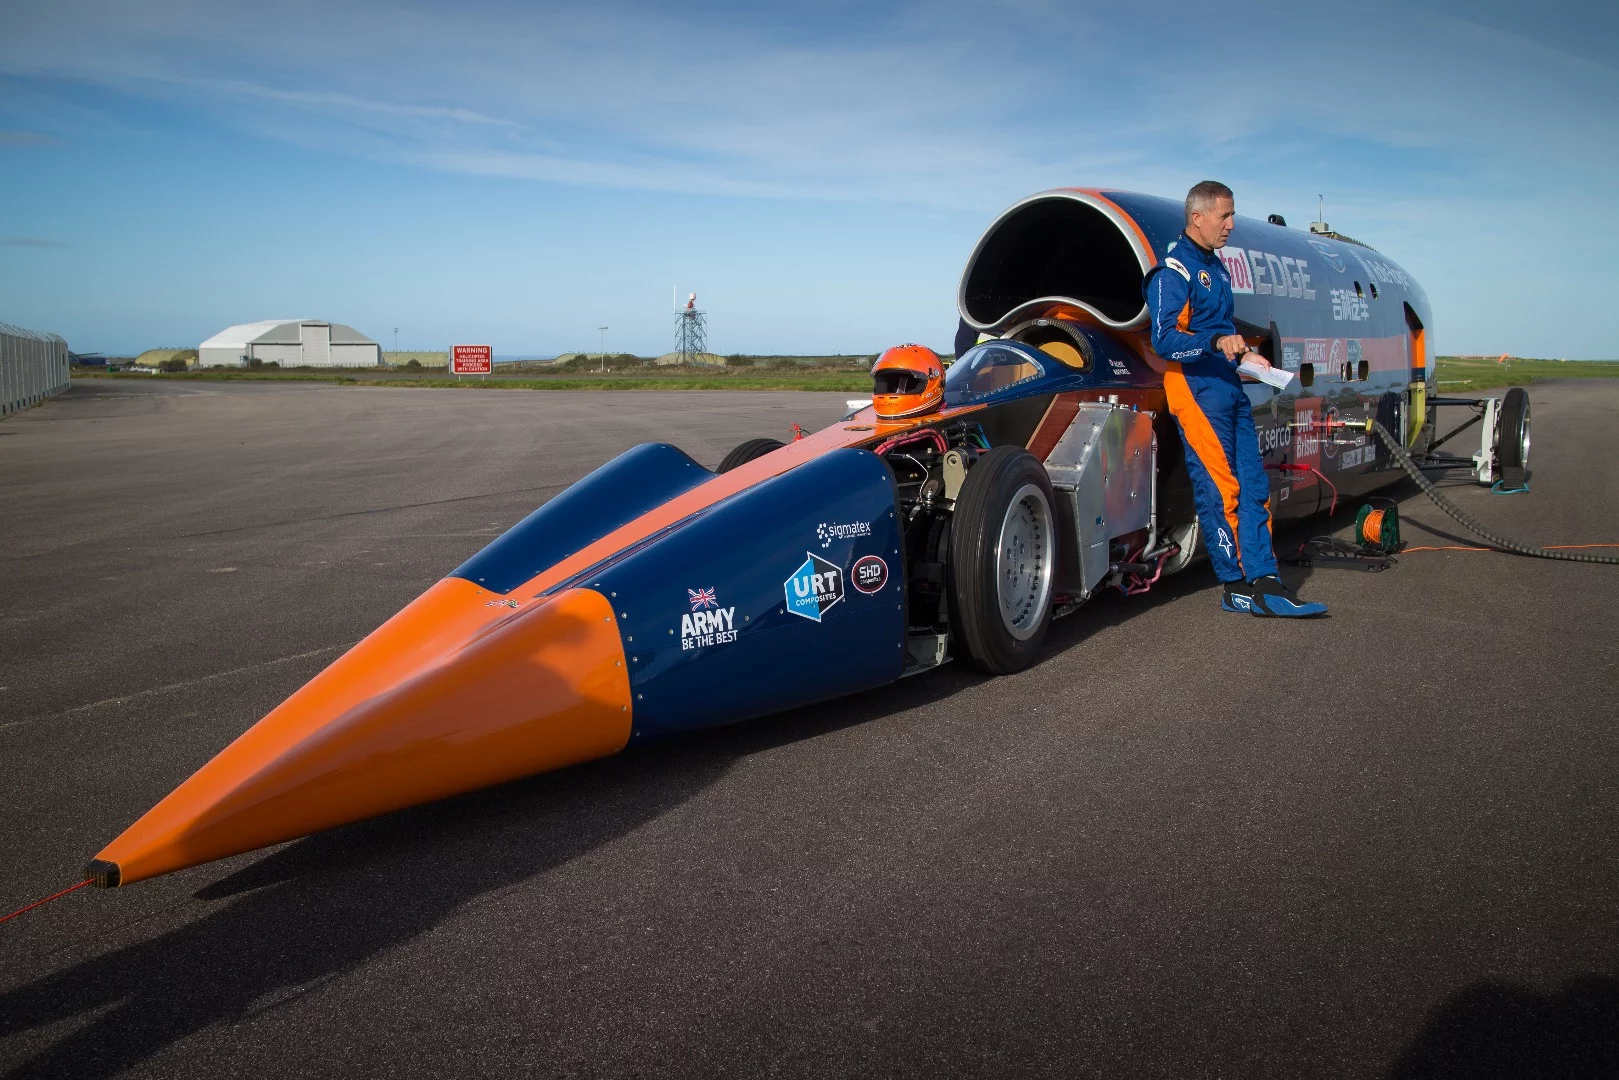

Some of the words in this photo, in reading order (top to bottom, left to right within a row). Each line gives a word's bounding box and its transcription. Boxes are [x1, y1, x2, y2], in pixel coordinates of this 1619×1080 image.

[1219, 249, 1252, 289] trol
[1248, 250, 1316, 300] EDGE
[1265, 426, 1291, 450] serco
[1296, 432, 1319, 459] Bristol
[829, 520, 871, 539] sigmatex
[859, 564, 881, 579] SHD
[793, 571, 838, 597] URT
[795, 592, 837, 607] COMPOSITES
[681, 606, 736, 638] ARMY
[682, 637, 694, 651] BE
[697, 634, 715, 648] THE
[716, 630, 738, 644] BEST
